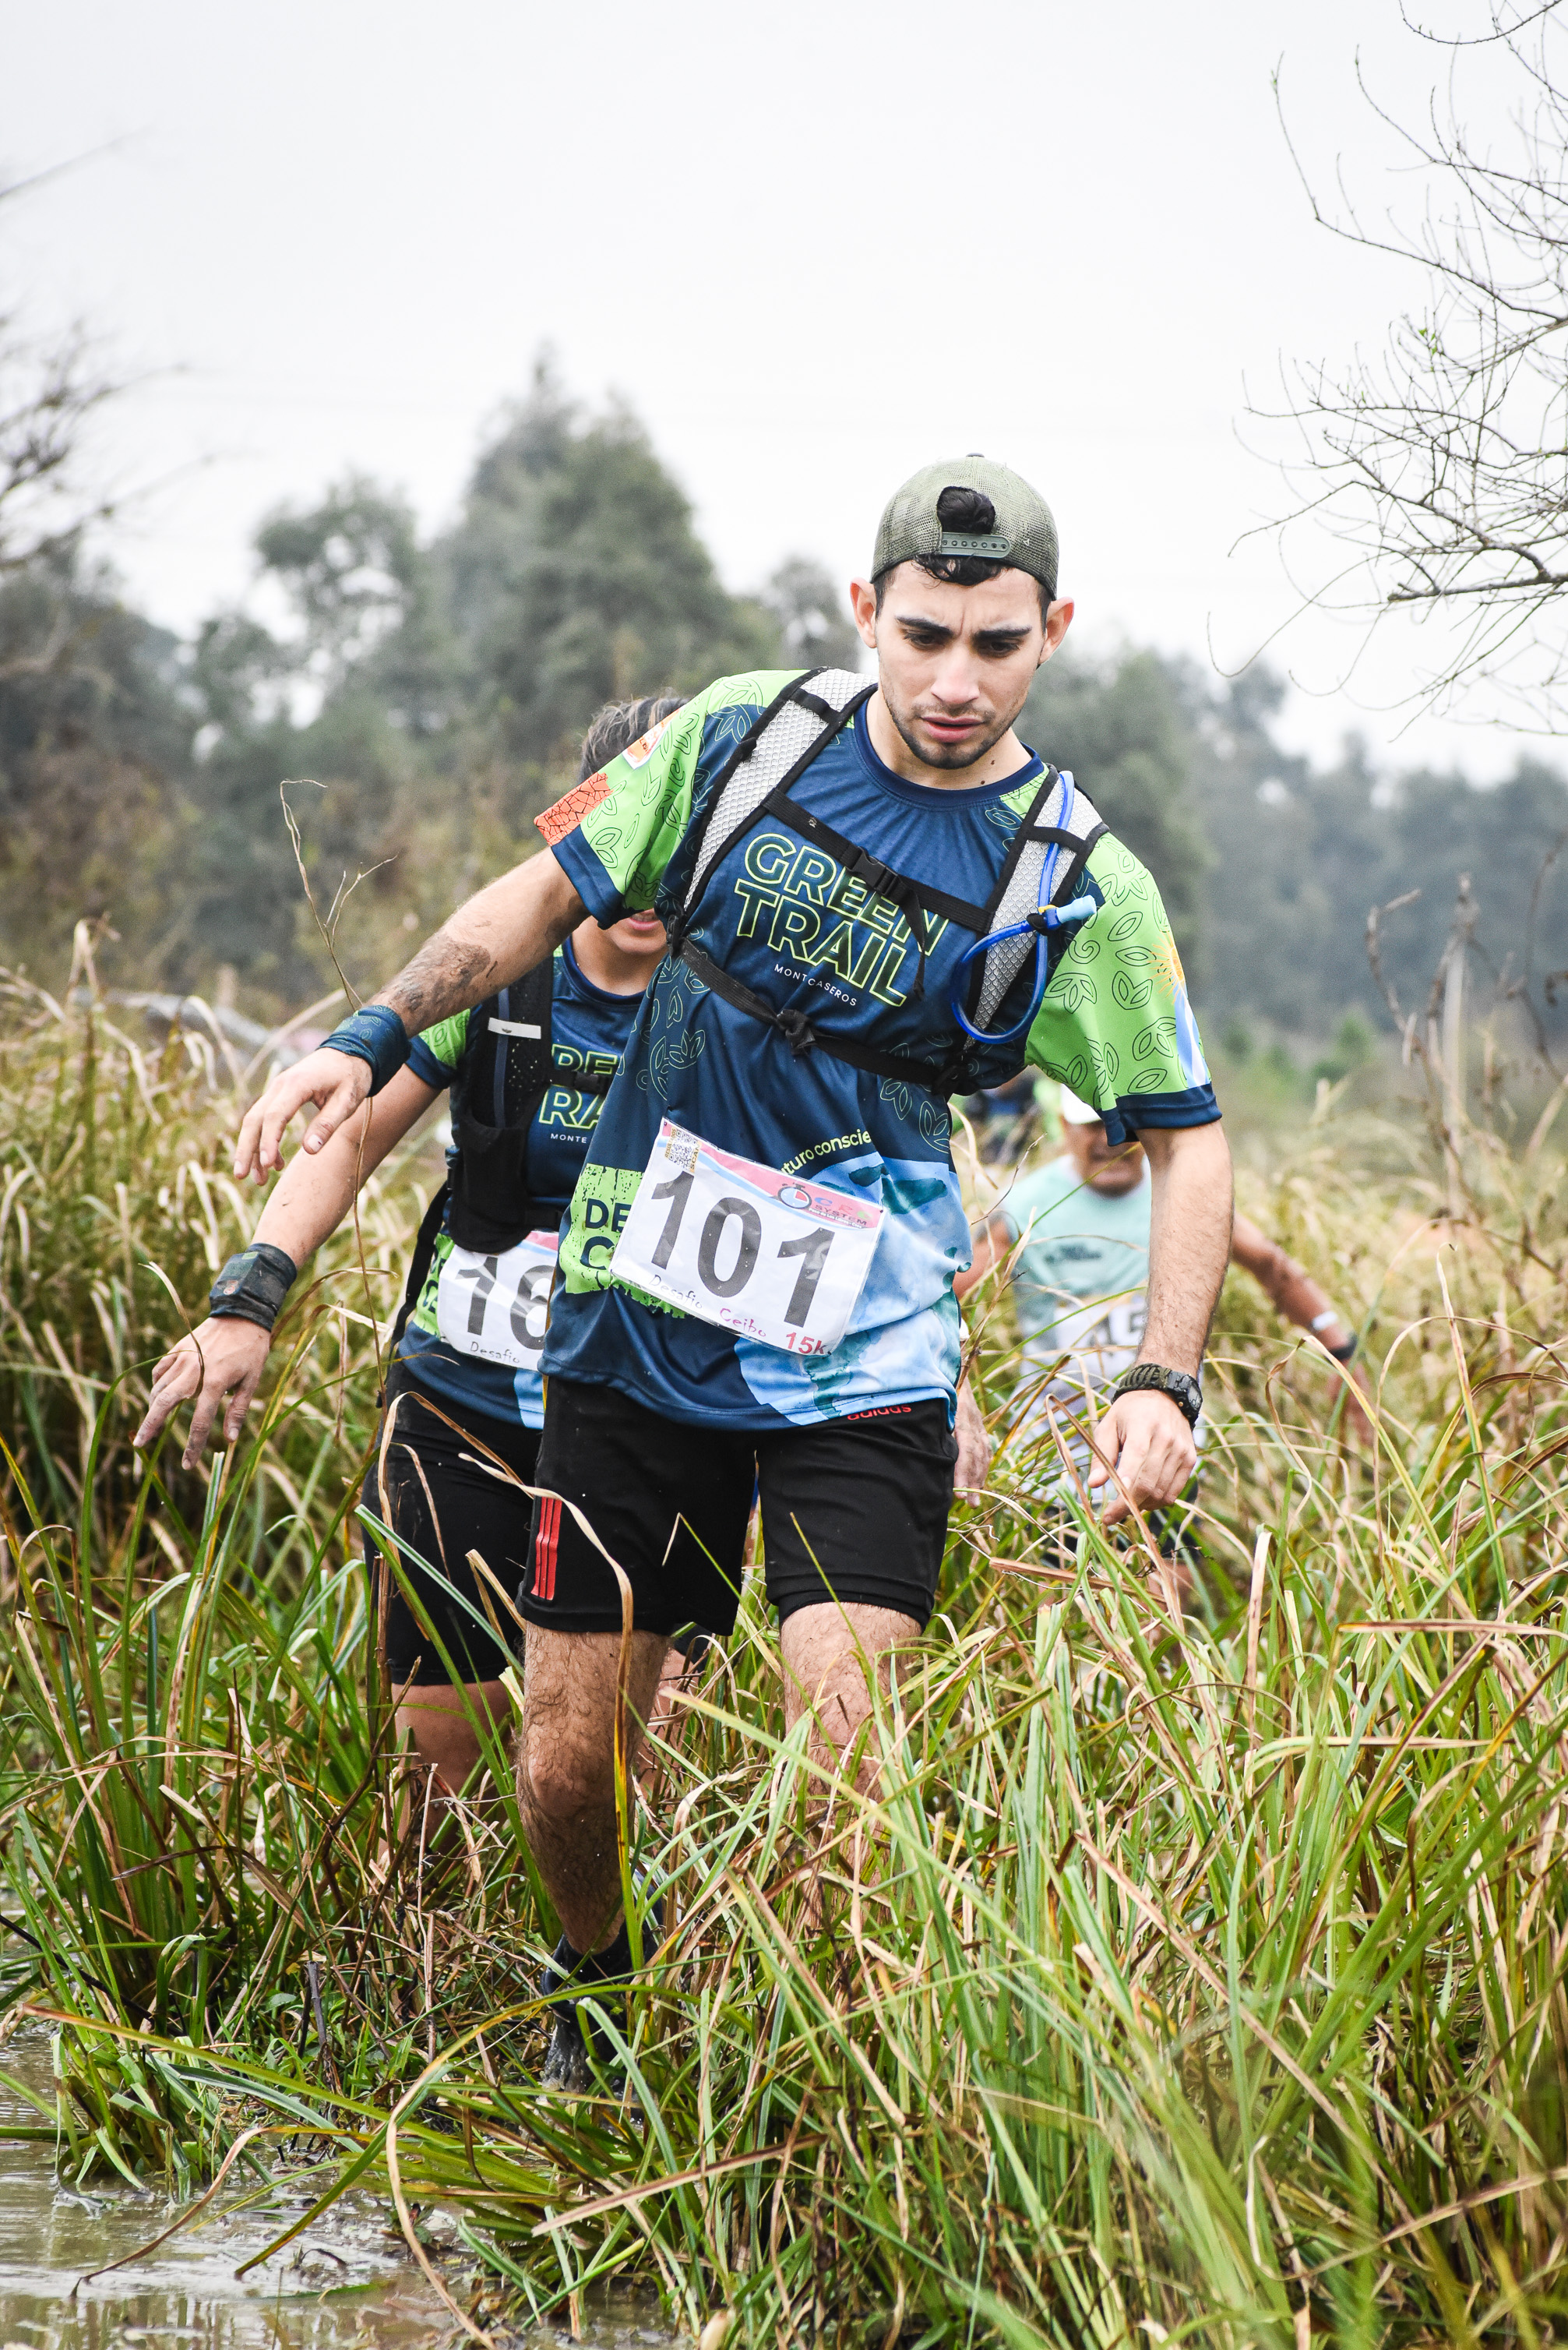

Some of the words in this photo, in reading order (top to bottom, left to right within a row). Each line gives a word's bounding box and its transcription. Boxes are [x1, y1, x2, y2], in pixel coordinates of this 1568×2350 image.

[745, 833, 949, 956] GREEN
[735, 878, 907, 1007] TRAIL
[551, 1133, 587, 1144] MONTE
[651, 1171, 835, 1328] 101
[649, 1274, 703, 1310] Desafio
[720, 1307, 766, 1337] Ceibo
[470, 1341, 520, 1364] Desafio
